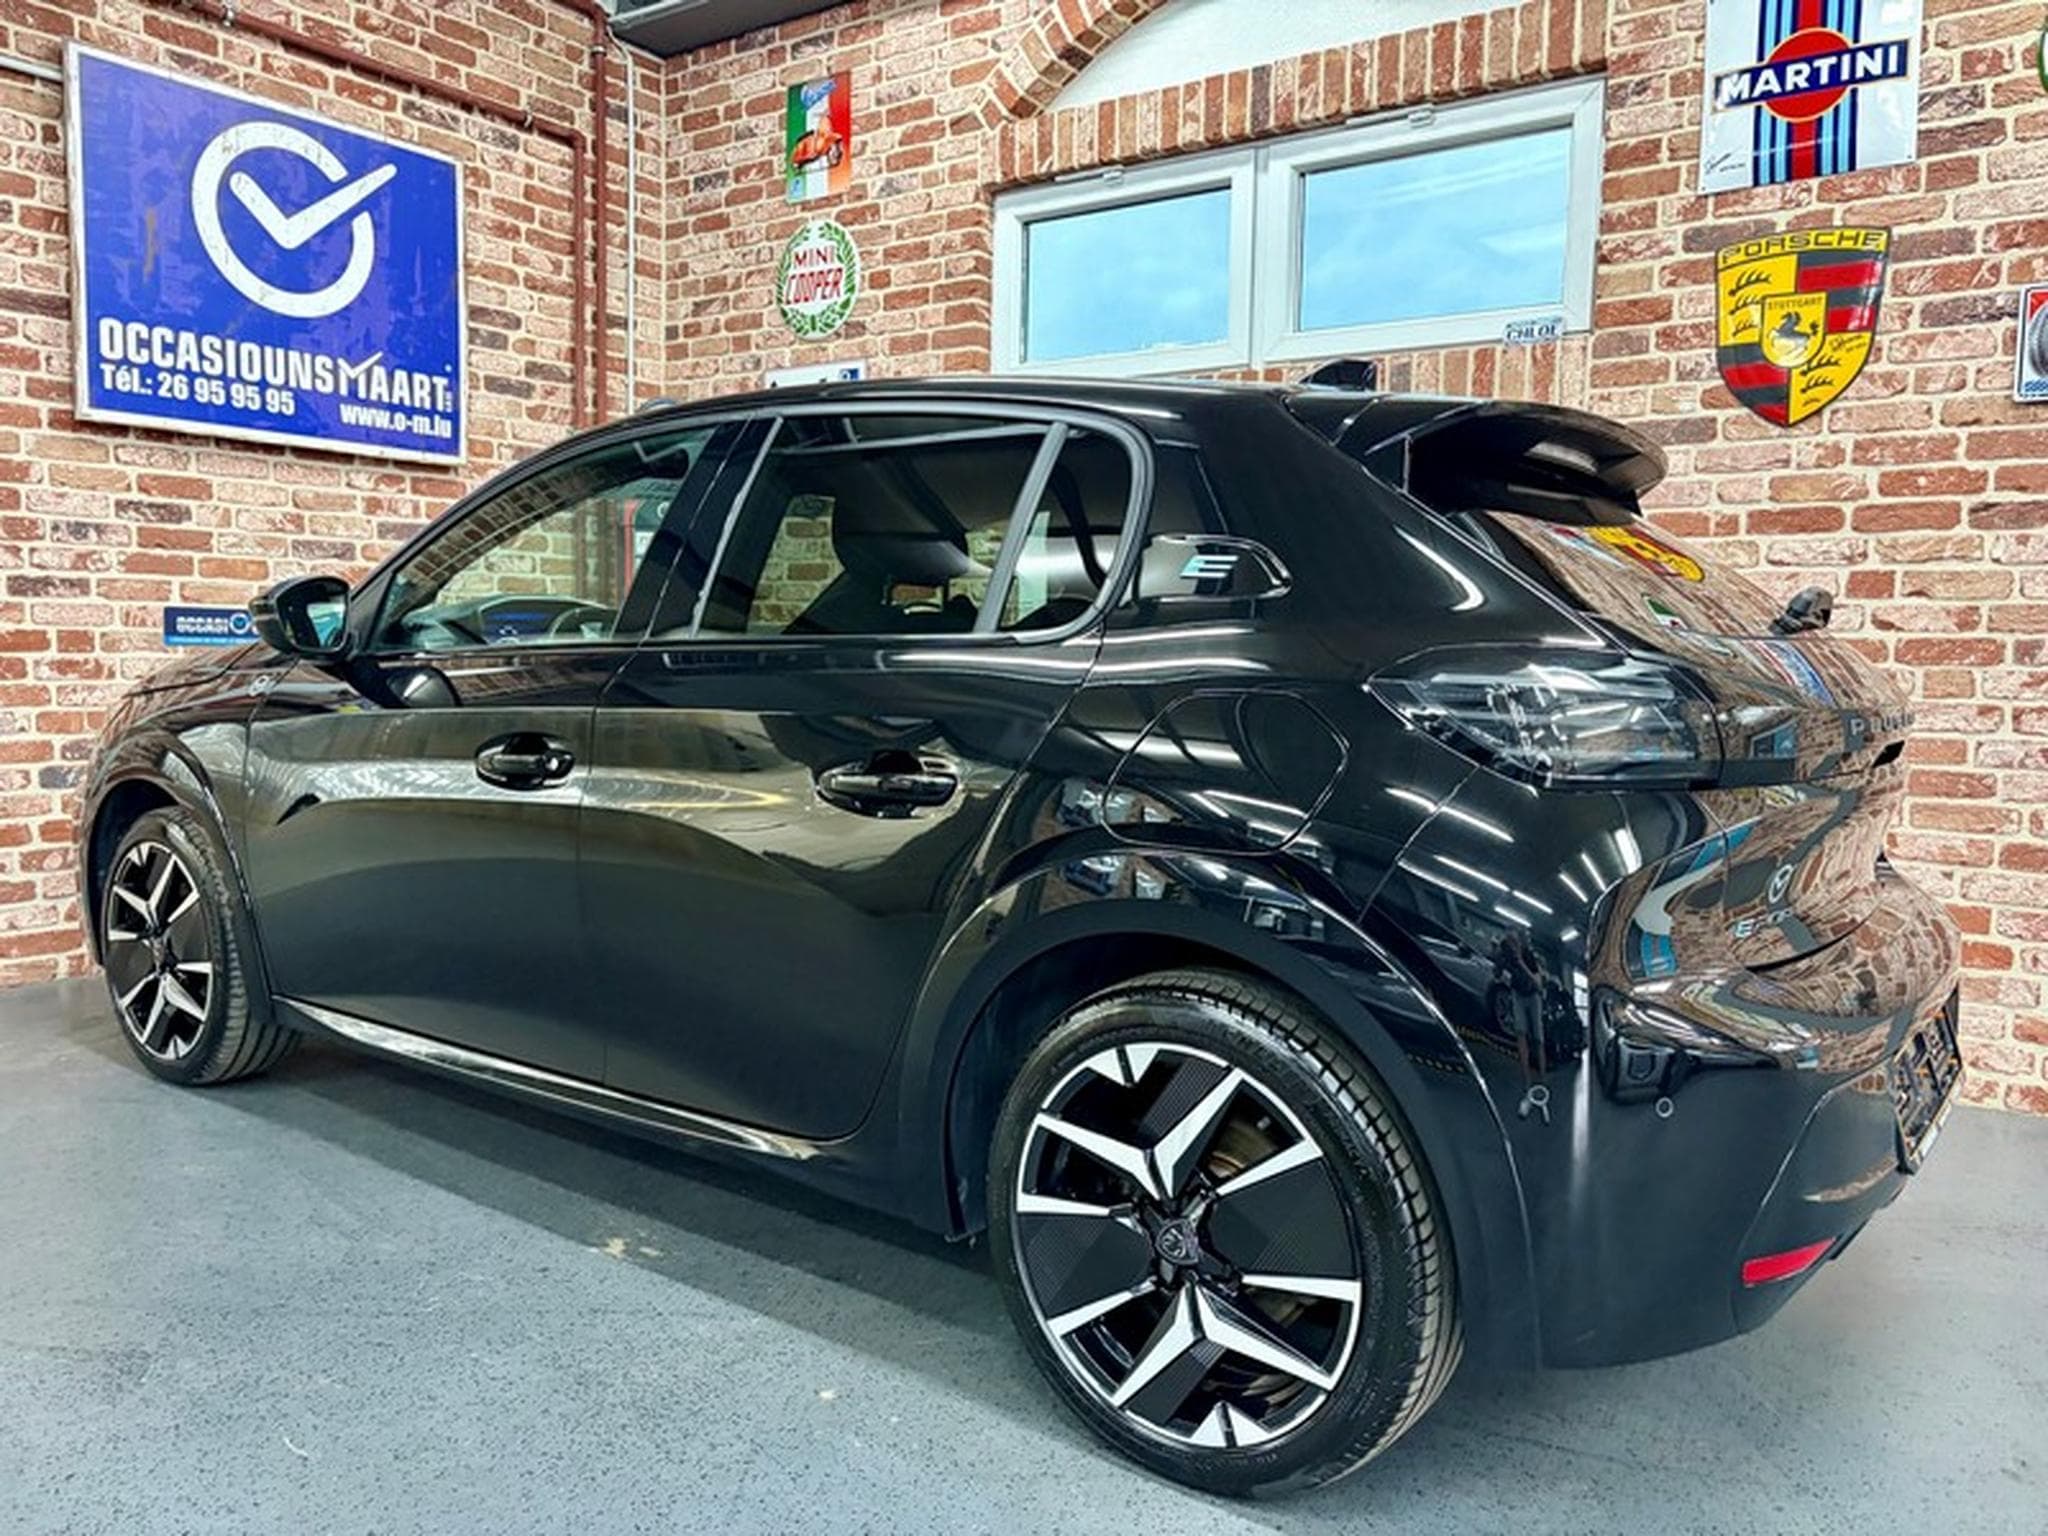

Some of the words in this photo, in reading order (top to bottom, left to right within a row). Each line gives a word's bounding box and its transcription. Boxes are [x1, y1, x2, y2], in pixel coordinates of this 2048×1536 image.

[1721, 45, 1898, 101] MARTINI
[794, 245, 836, 268] MINI
[1721, 231, 1884, 265] PORSCHE
[785, 267, 844, 306] COOPER
[100, 363, 153, 395] Tél.:
[158, 372, 189, 400] 26
[194, 379, 226, 406] 95
[230, 384, 262, 411] 95
[265, 389, 296, 416] 95
[340, 403, 452, 439] www.o-m.lu
